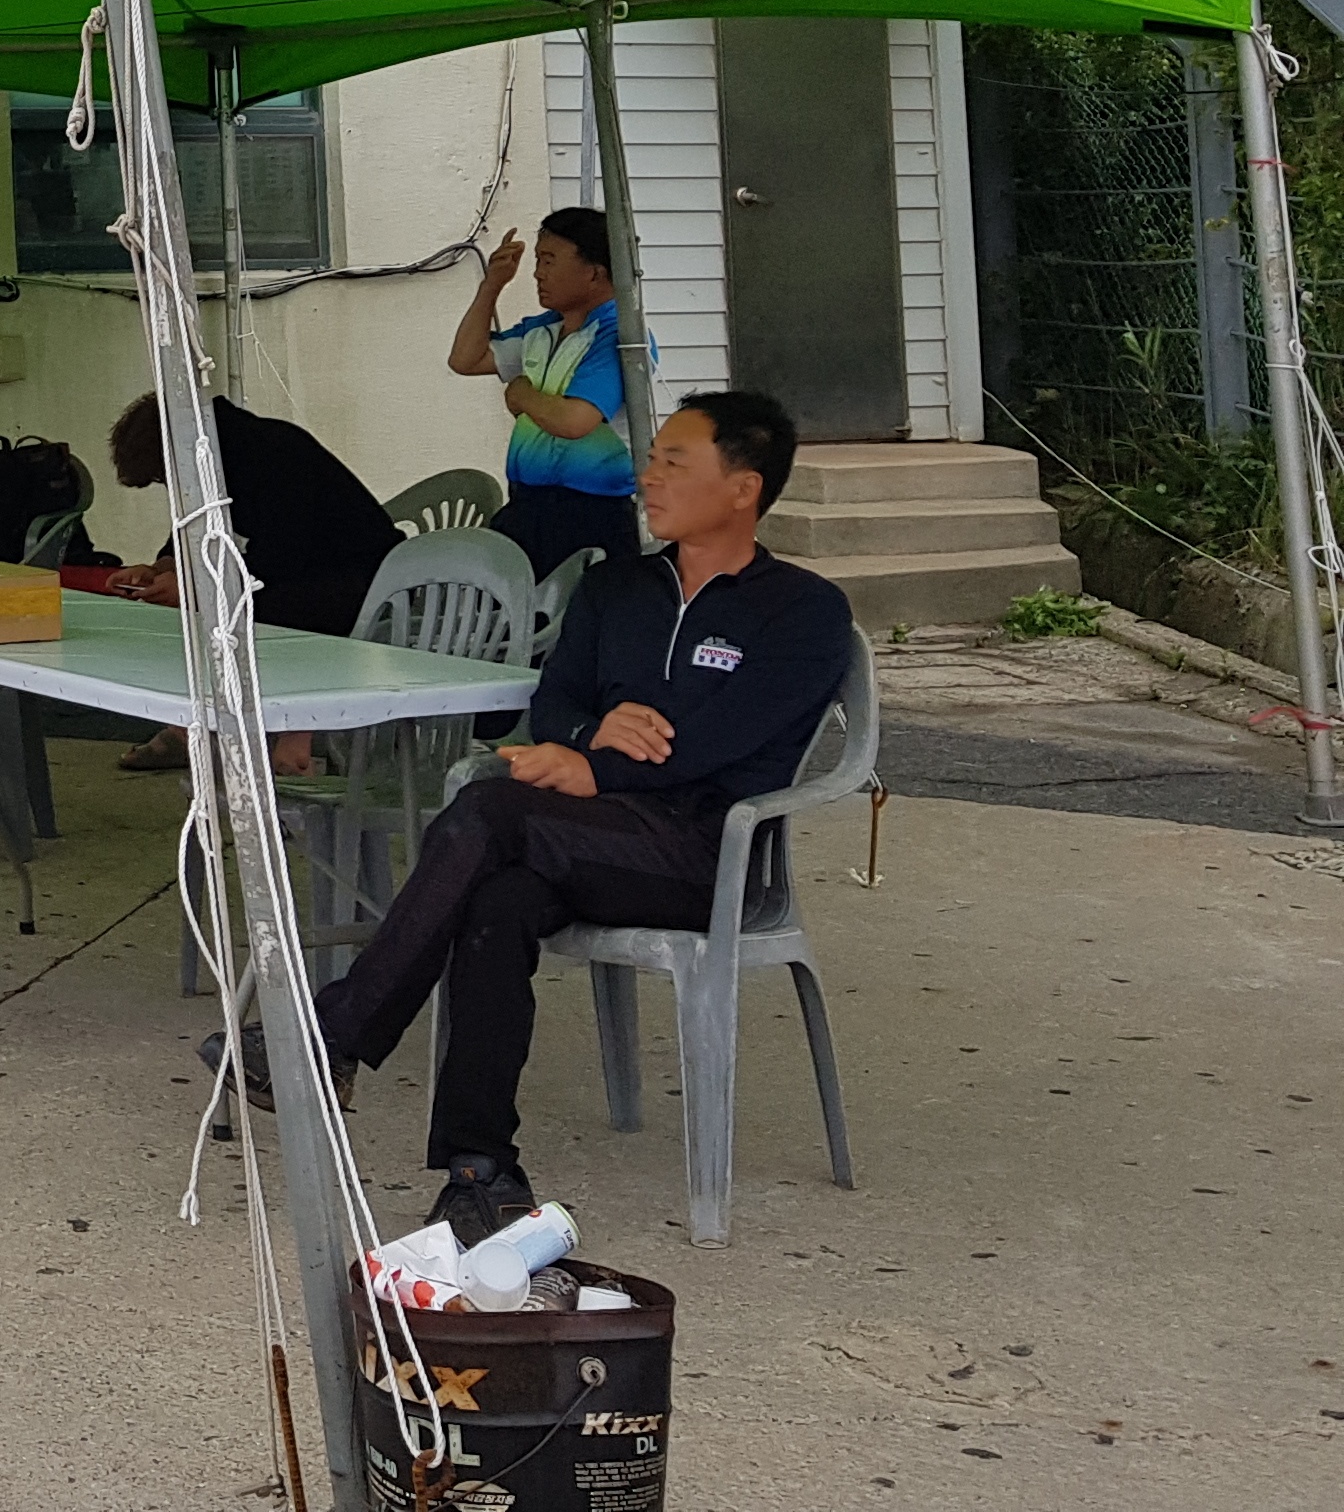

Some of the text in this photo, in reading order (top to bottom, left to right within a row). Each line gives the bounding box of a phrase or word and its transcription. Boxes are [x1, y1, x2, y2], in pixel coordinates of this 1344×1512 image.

[700, 647, 742, 662] HONDA
[581, 1411, 664, 1435] Kixx
[407, 1416, 481, 1467] DL
[636, 1436, 658, 1455] DL
